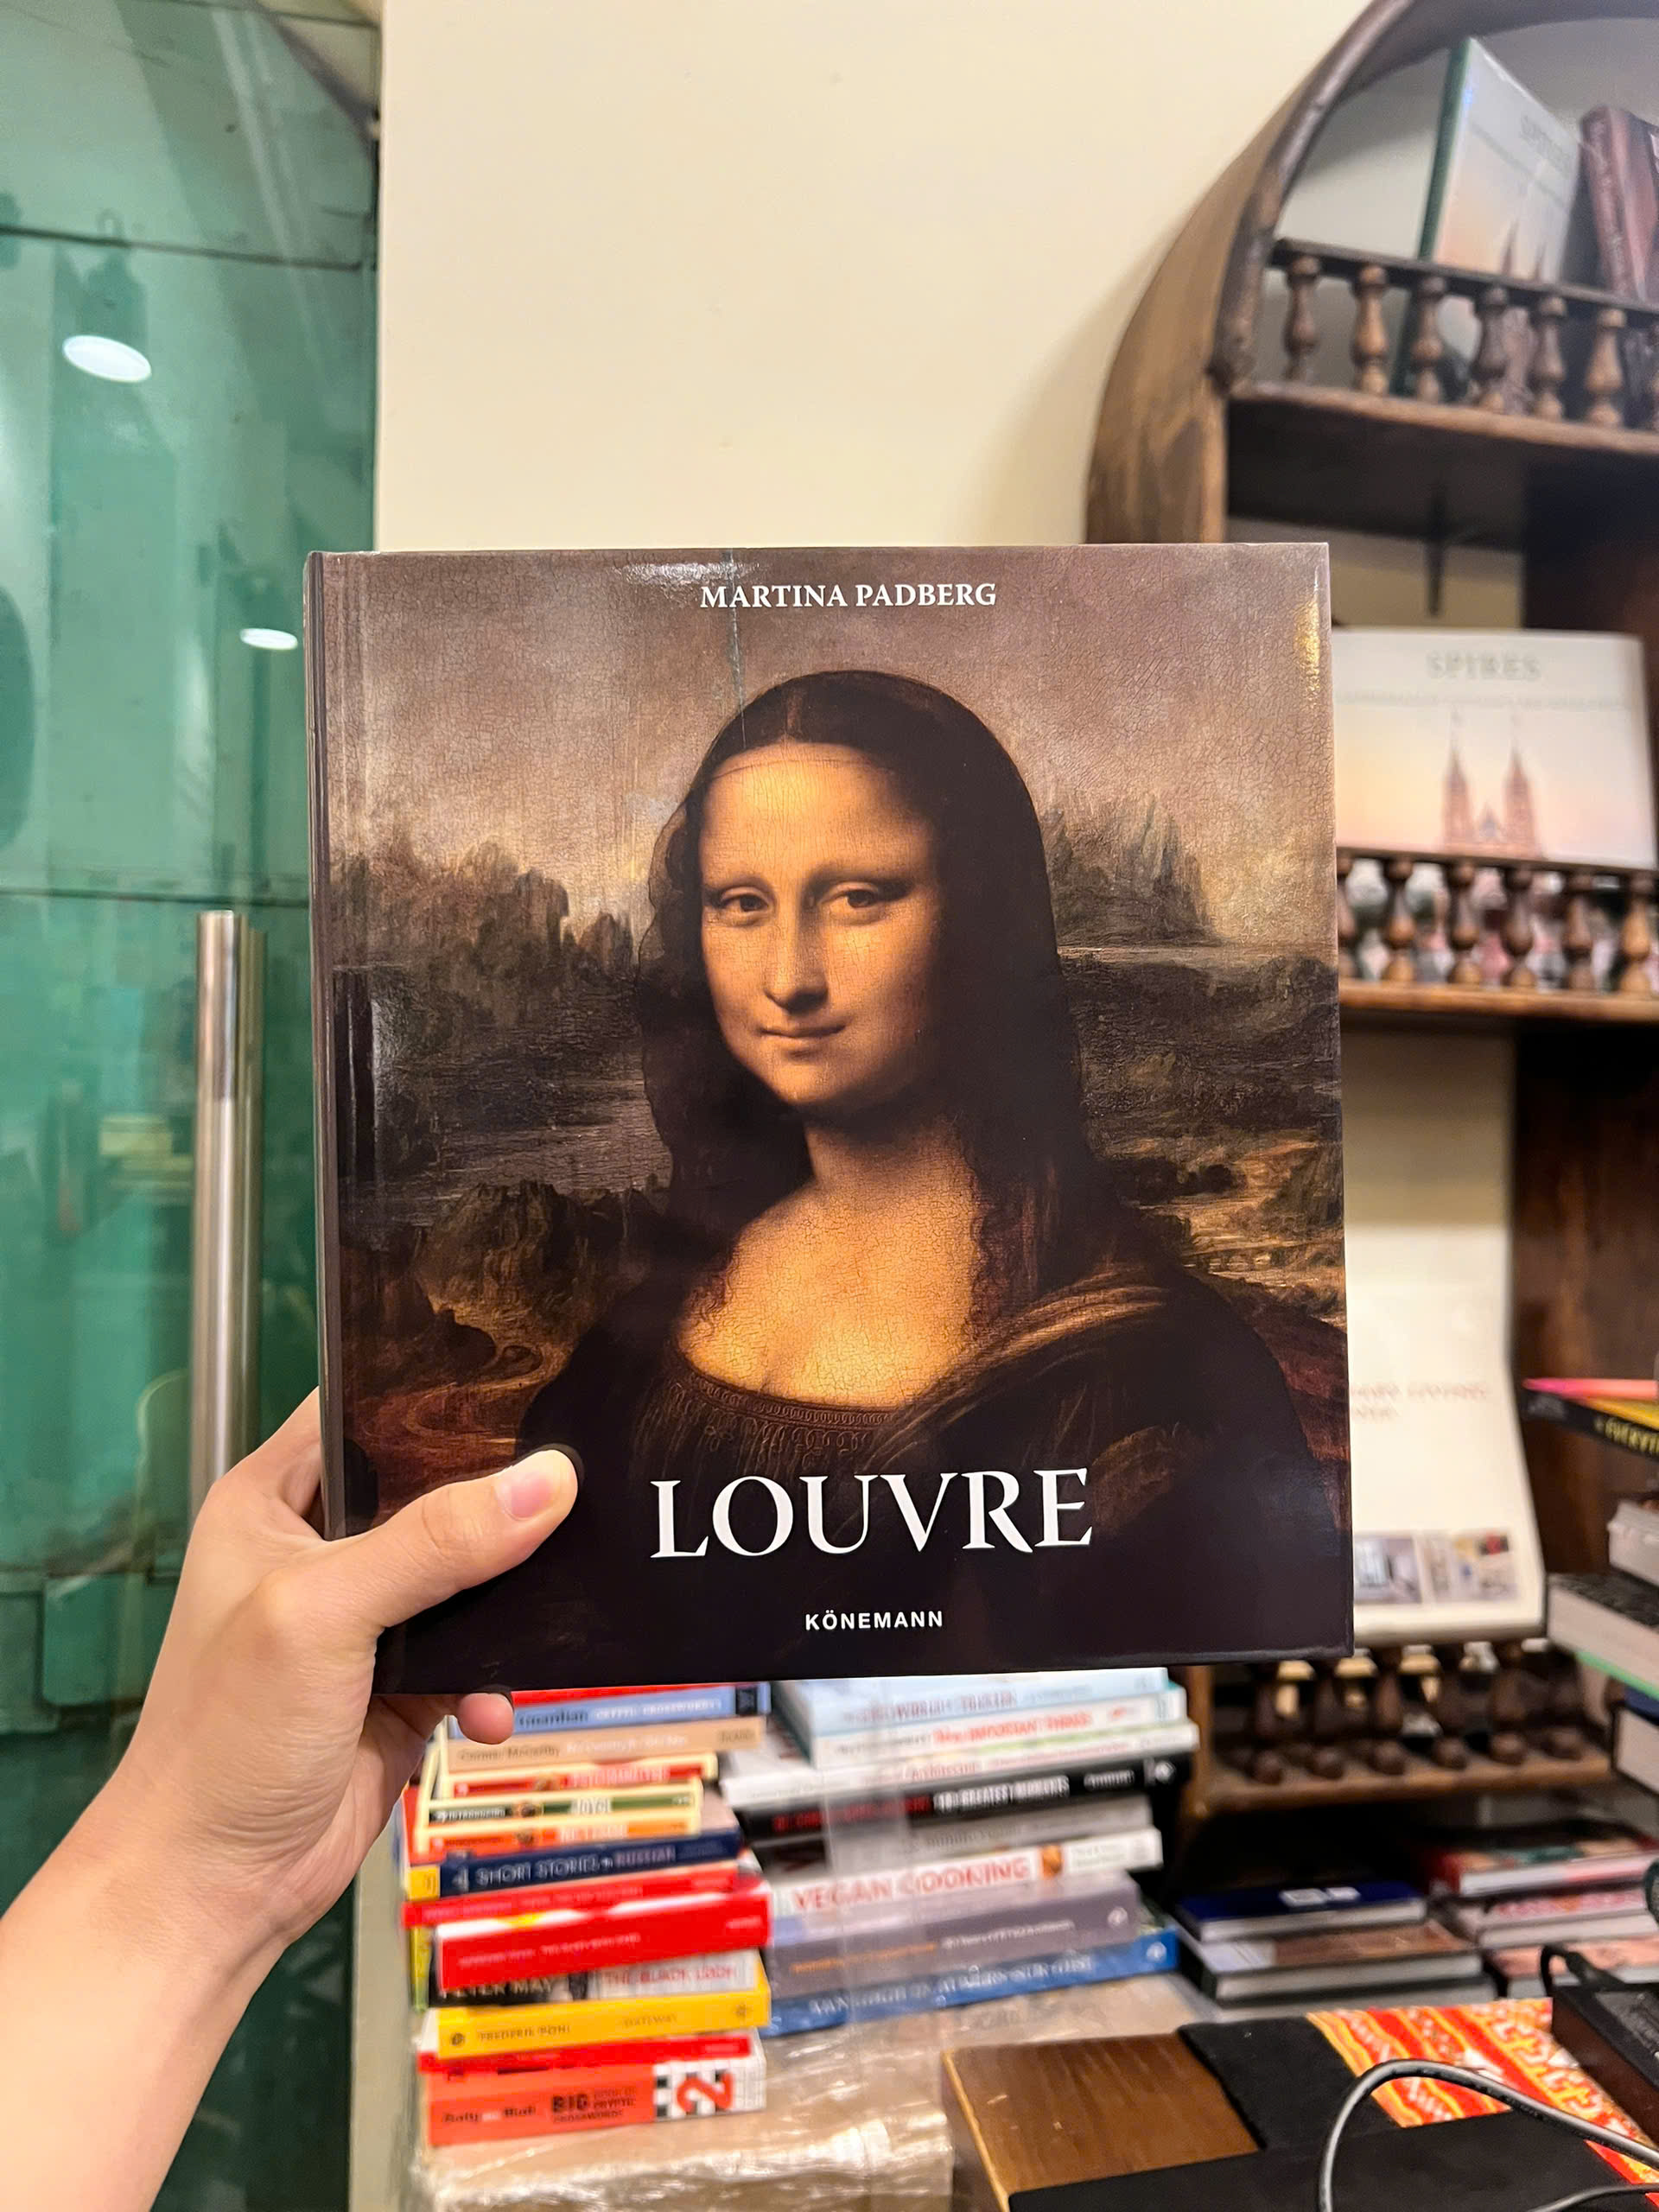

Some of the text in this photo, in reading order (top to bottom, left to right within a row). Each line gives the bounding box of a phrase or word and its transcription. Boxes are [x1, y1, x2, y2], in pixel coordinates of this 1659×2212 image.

[700, 582, 996, 608] MARTINA PADBERG
[1426, 649, 1541, 682] SPIRES
[650, 1467, 1093, 1558] LOUVRE
[804, 1609, 944, 1631] KÖNEMANN
[476, 1860, 531, 1885] SHORT
[614, 1845, 677, 1867] RUSSIAN
[793, 1872, 893, 1910] VEGAN
[895, 1855, 1032, 1897] COOKING
[550, 2092, 590, 2113] BIG
